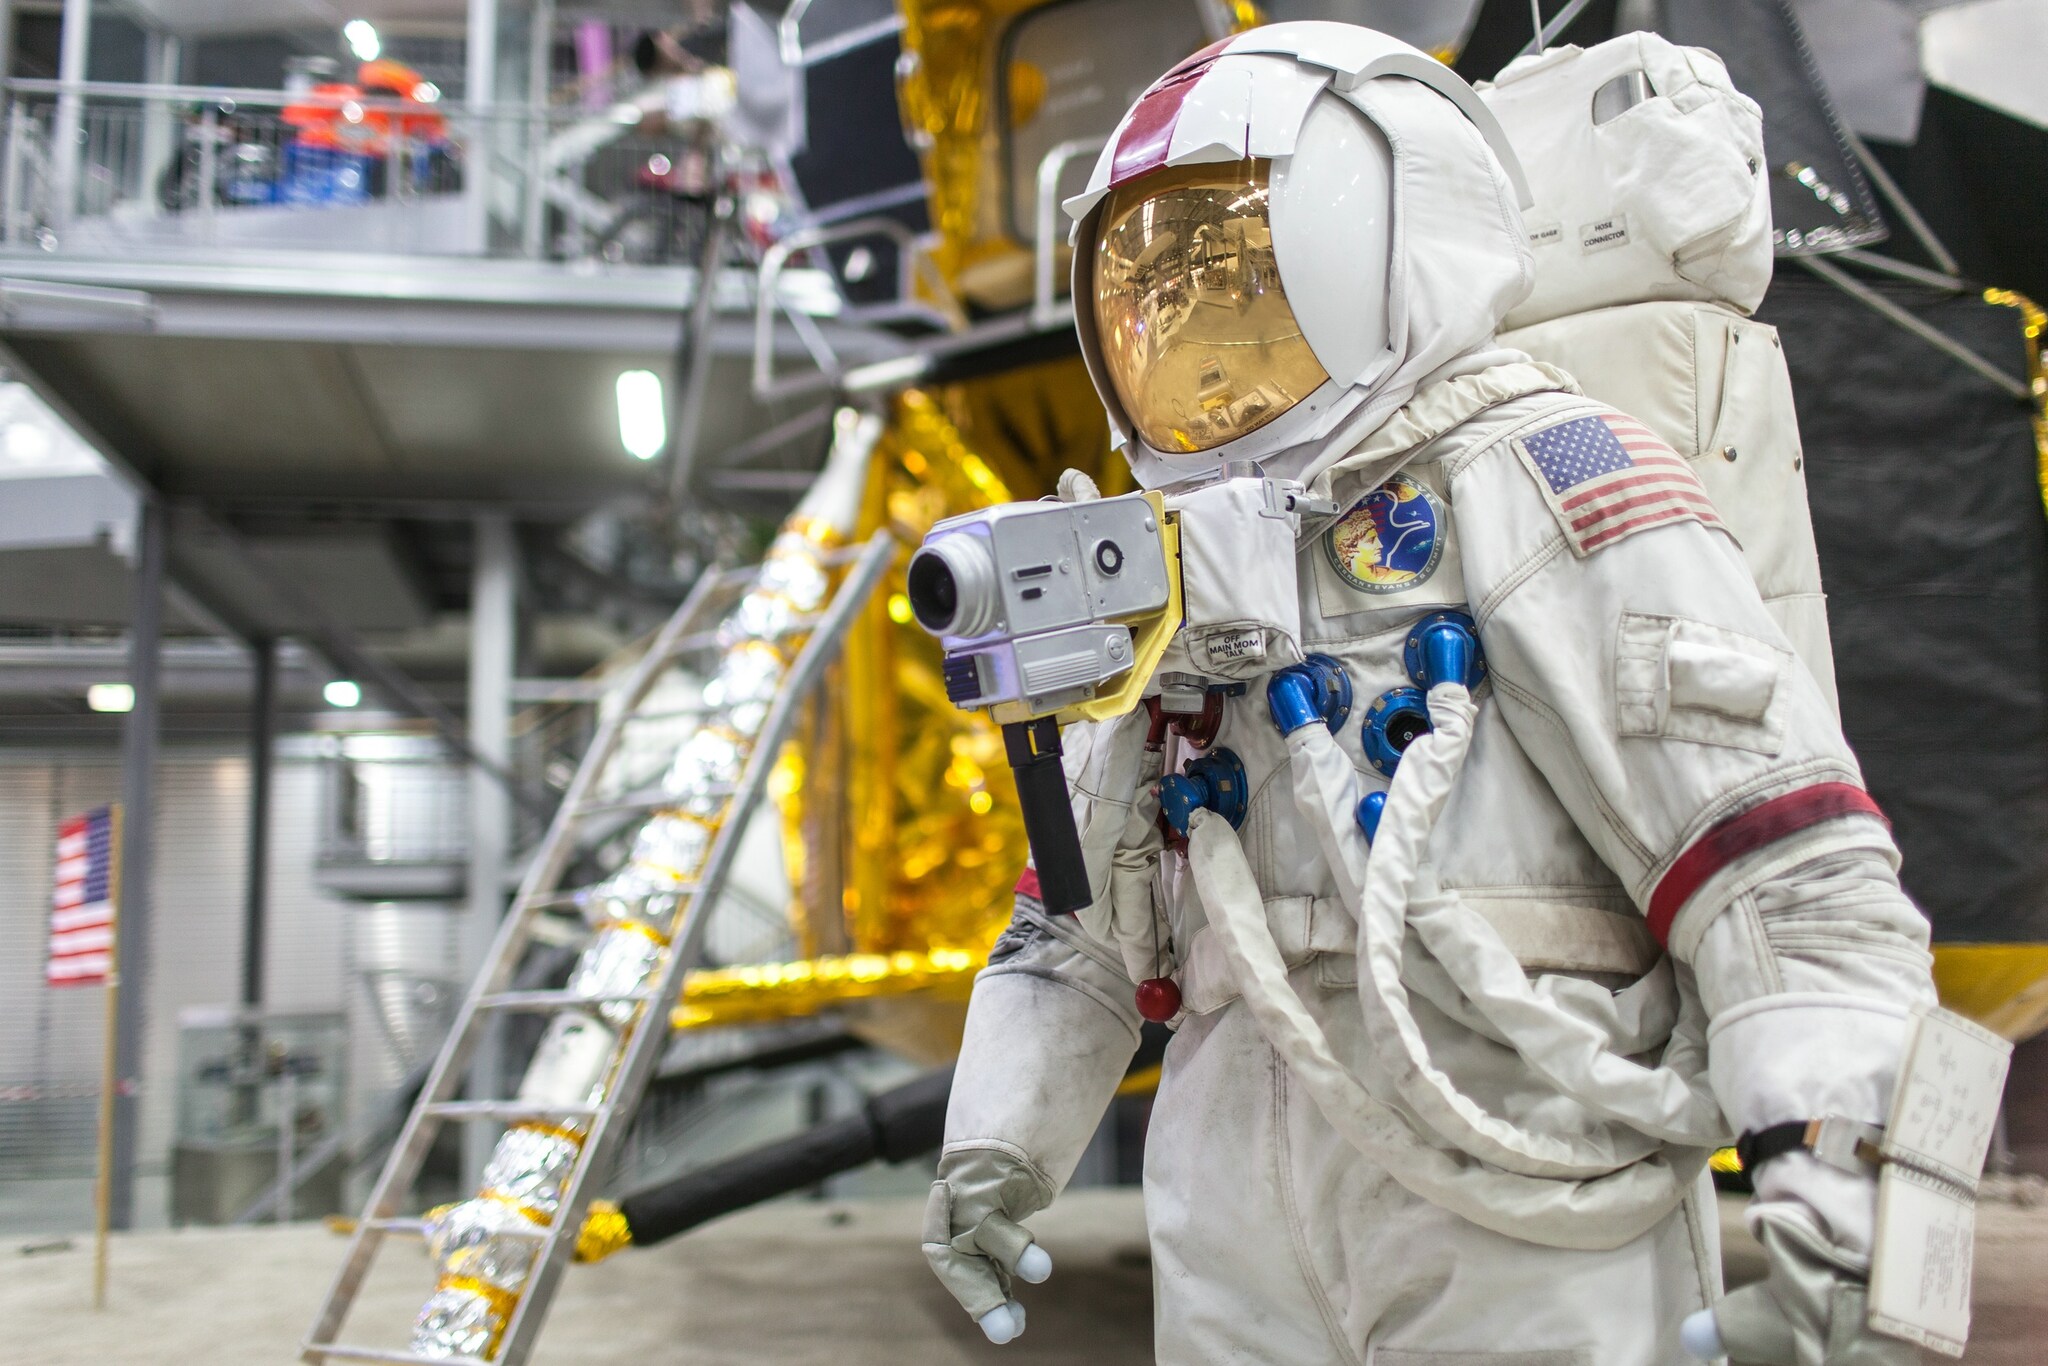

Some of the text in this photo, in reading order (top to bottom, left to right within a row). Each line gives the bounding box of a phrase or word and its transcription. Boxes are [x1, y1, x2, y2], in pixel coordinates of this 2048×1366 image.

[1594, 221, 1613, 232] HOSE
[1584, 230, 1625, 247] CONNECTOR
[1403, 477, 1437, 505] XVII
[1333, 535, 1443, 591] CERNAN EVANS SCHMITT
[1224, 634, 1240, 644] OFF
[1209, 640, 1258, 654] MAIN MOM
[1224, 649, 1245, 658] TALK
